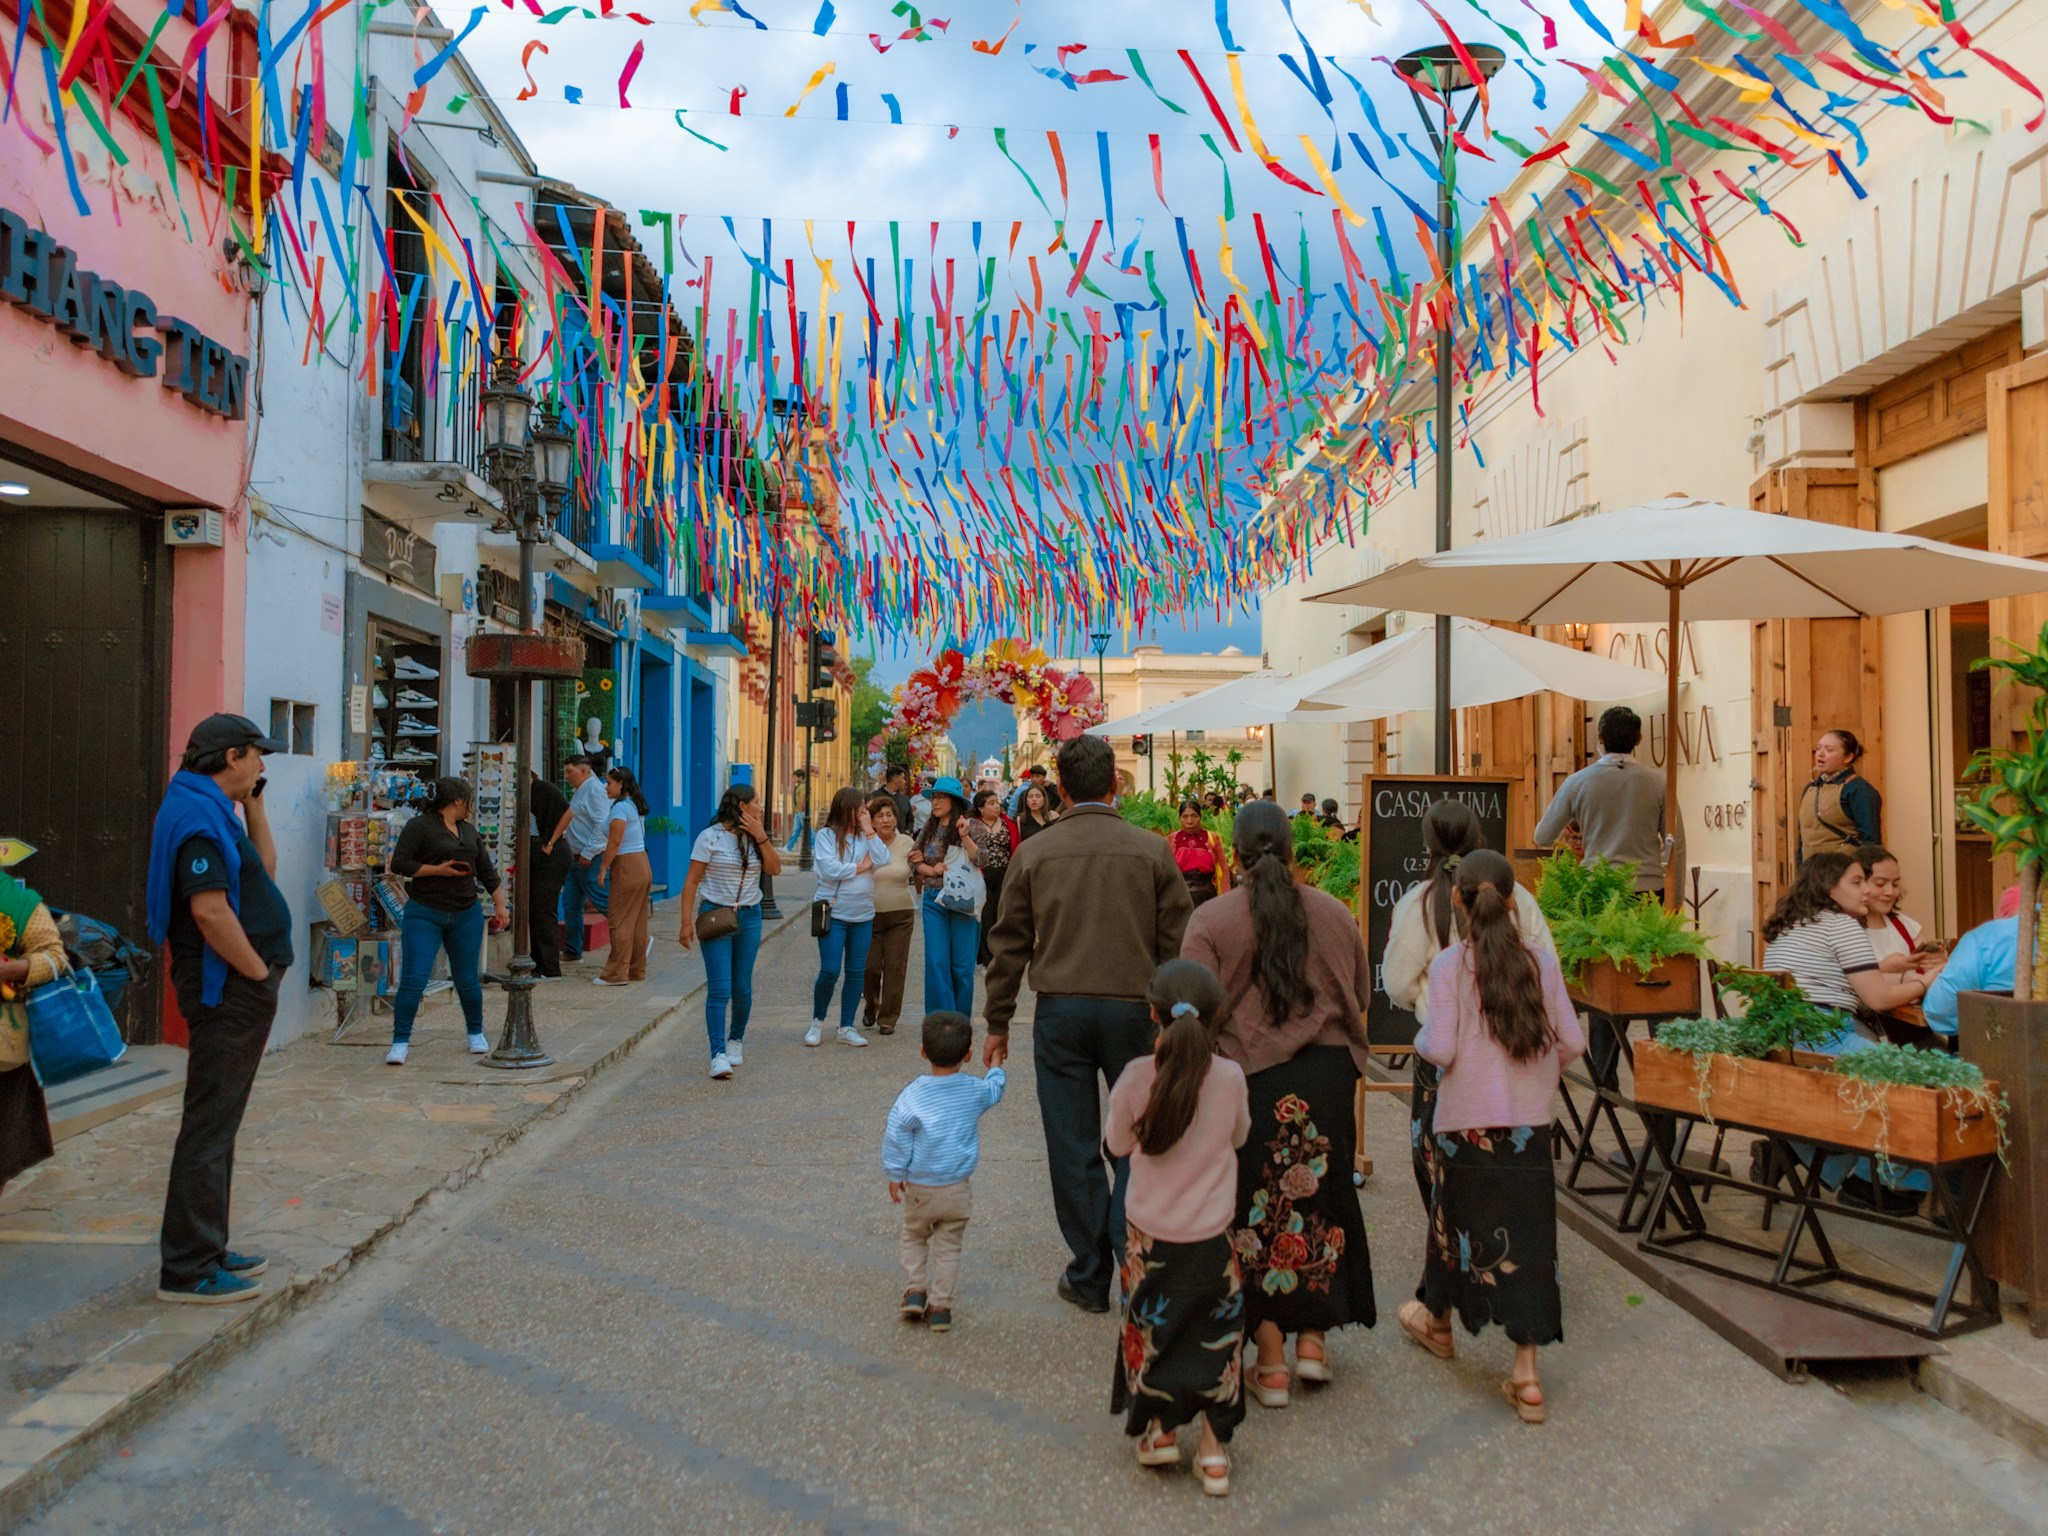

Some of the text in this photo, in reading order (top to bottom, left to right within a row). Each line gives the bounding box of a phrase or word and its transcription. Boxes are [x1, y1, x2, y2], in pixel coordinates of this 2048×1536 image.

[0, 208, 249, 419] HANG TEN
[384, 527, 417, 562] Doff
[1649, 704, 1721, 768] UNA
[1375, 789, 1432, 818] CASA
